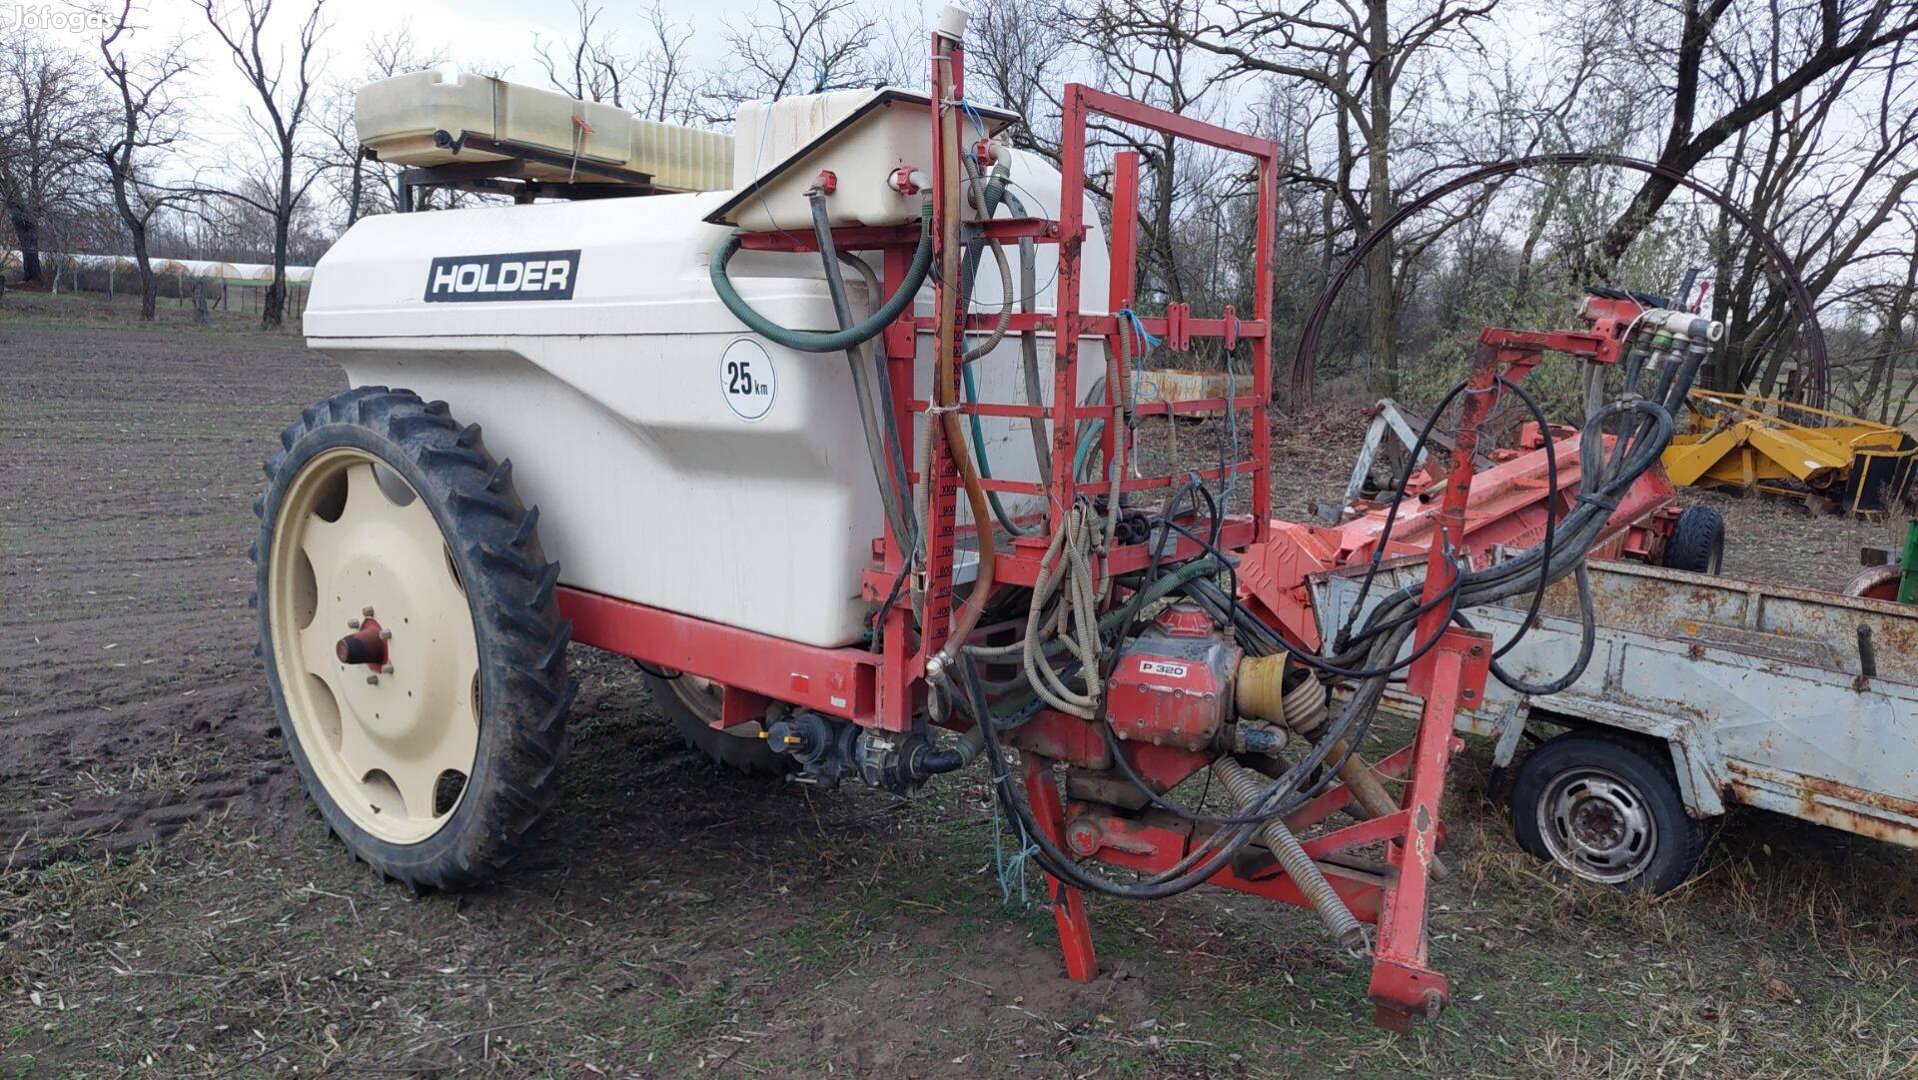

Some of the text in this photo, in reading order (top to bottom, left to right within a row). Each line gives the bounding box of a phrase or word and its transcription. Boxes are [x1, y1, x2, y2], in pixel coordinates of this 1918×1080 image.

[432, 260, 570, 293] HOLDER
[728, 361, 768, 395] 25 km
[1156, 665, 1184, 675] 320
